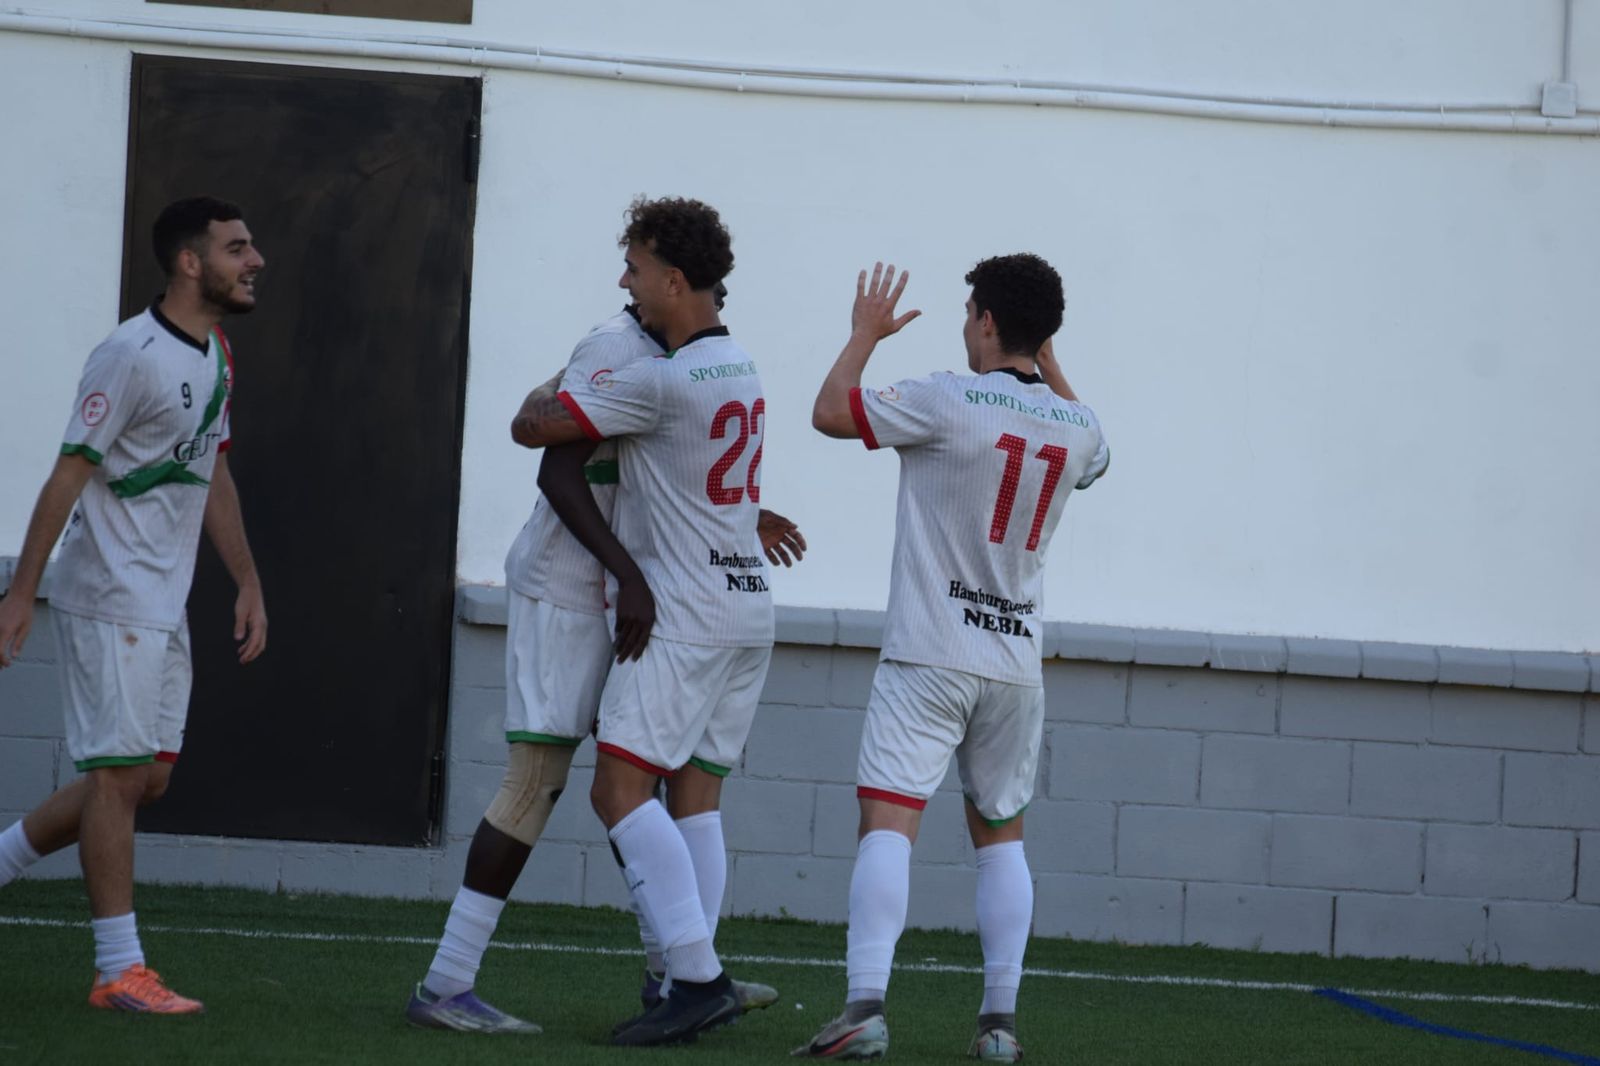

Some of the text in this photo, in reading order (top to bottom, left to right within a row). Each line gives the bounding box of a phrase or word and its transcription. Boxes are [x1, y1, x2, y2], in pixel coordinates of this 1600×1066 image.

[181, 382, 192, 409] 9
[965, 389, 1045, 418] SPORTING
[706, 397, 765, 506] 22
[988, 432, 1068, 552] 11
